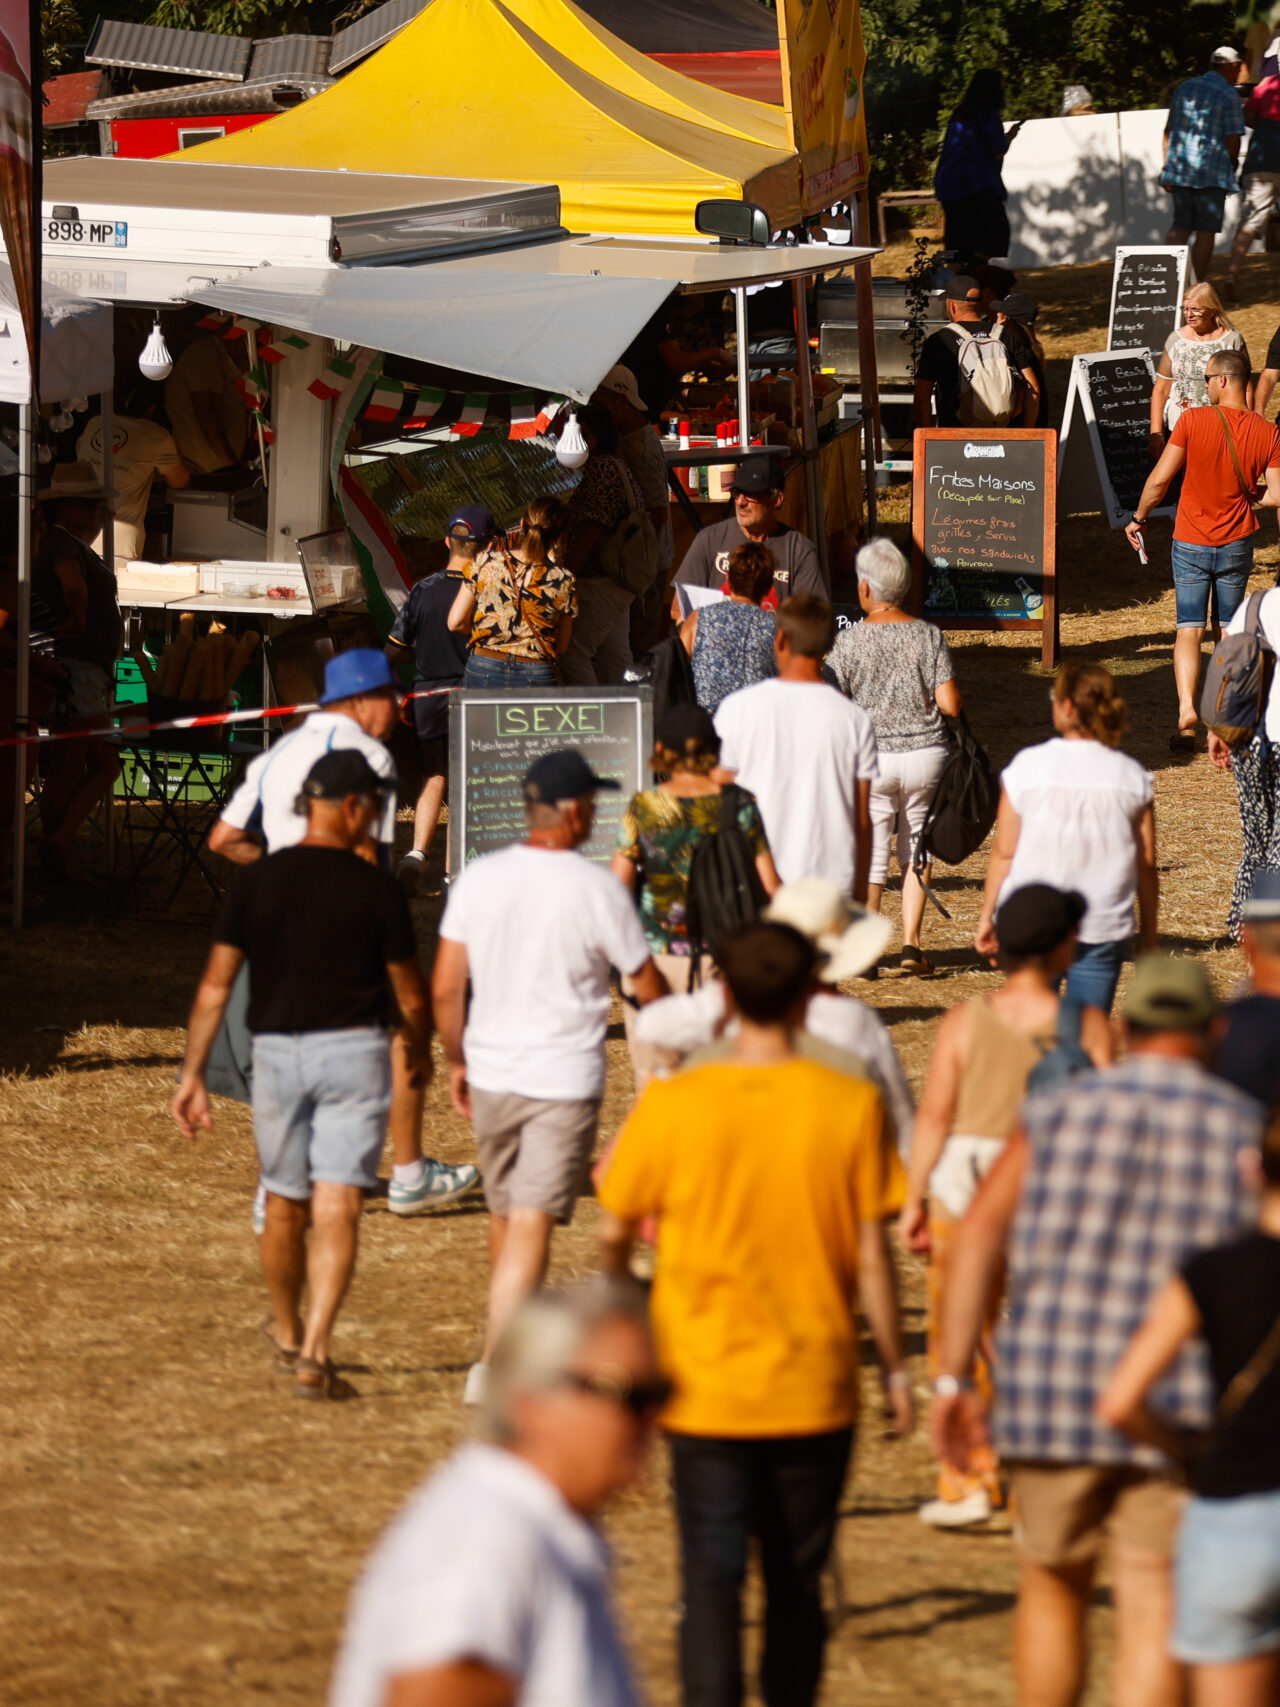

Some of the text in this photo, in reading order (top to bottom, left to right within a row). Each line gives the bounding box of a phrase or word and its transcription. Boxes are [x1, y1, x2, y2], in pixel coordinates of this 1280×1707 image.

[930, 465, 1036, 491] Frites Maisons
[931, 508, 987, 530] Légumes
[930, 544, 953, 554] avec
[958, 546, 976, 554] nos
[504, 705, 599, 733] SEXE
